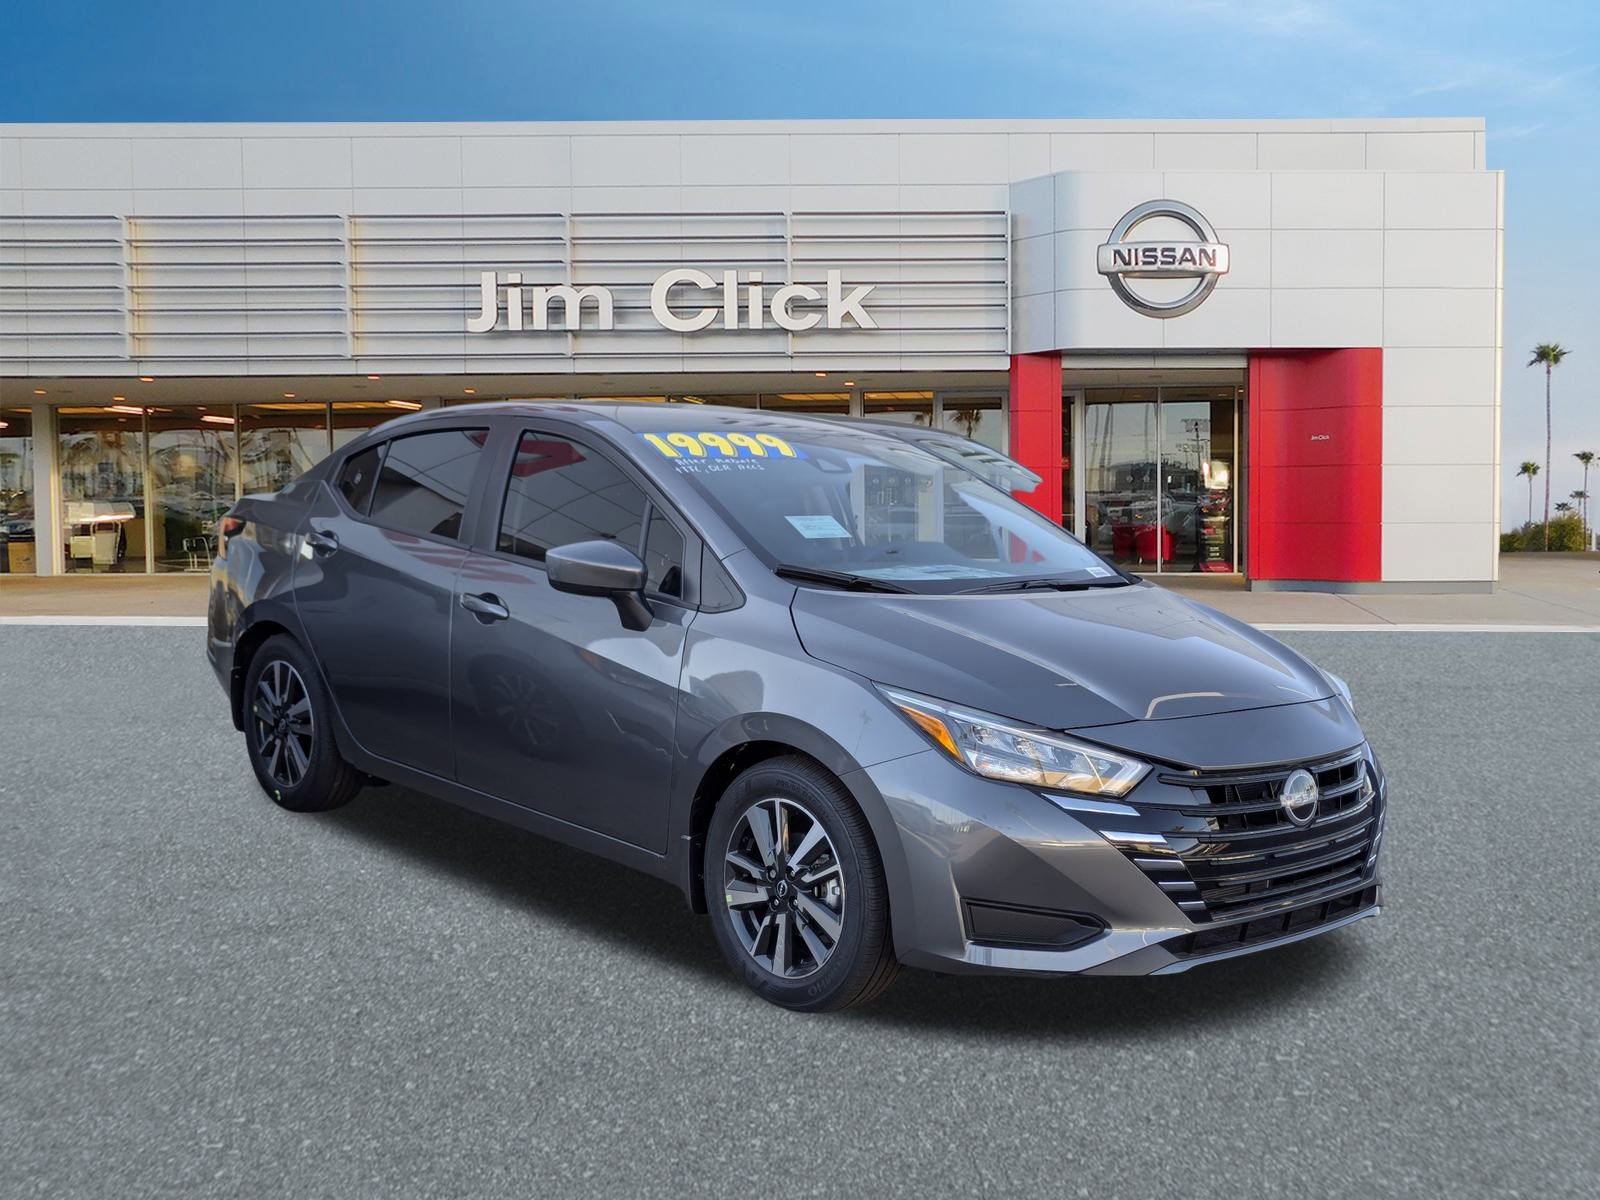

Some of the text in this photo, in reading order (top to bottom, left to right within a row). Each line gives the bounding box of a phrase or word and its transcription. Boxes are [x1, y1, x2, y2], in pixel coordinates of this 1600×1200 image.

[1112, 247, 1217, 267] NISSAN
[466, 267, 880, 333] Jim Click
[643, 432, 798, 458] 19999
